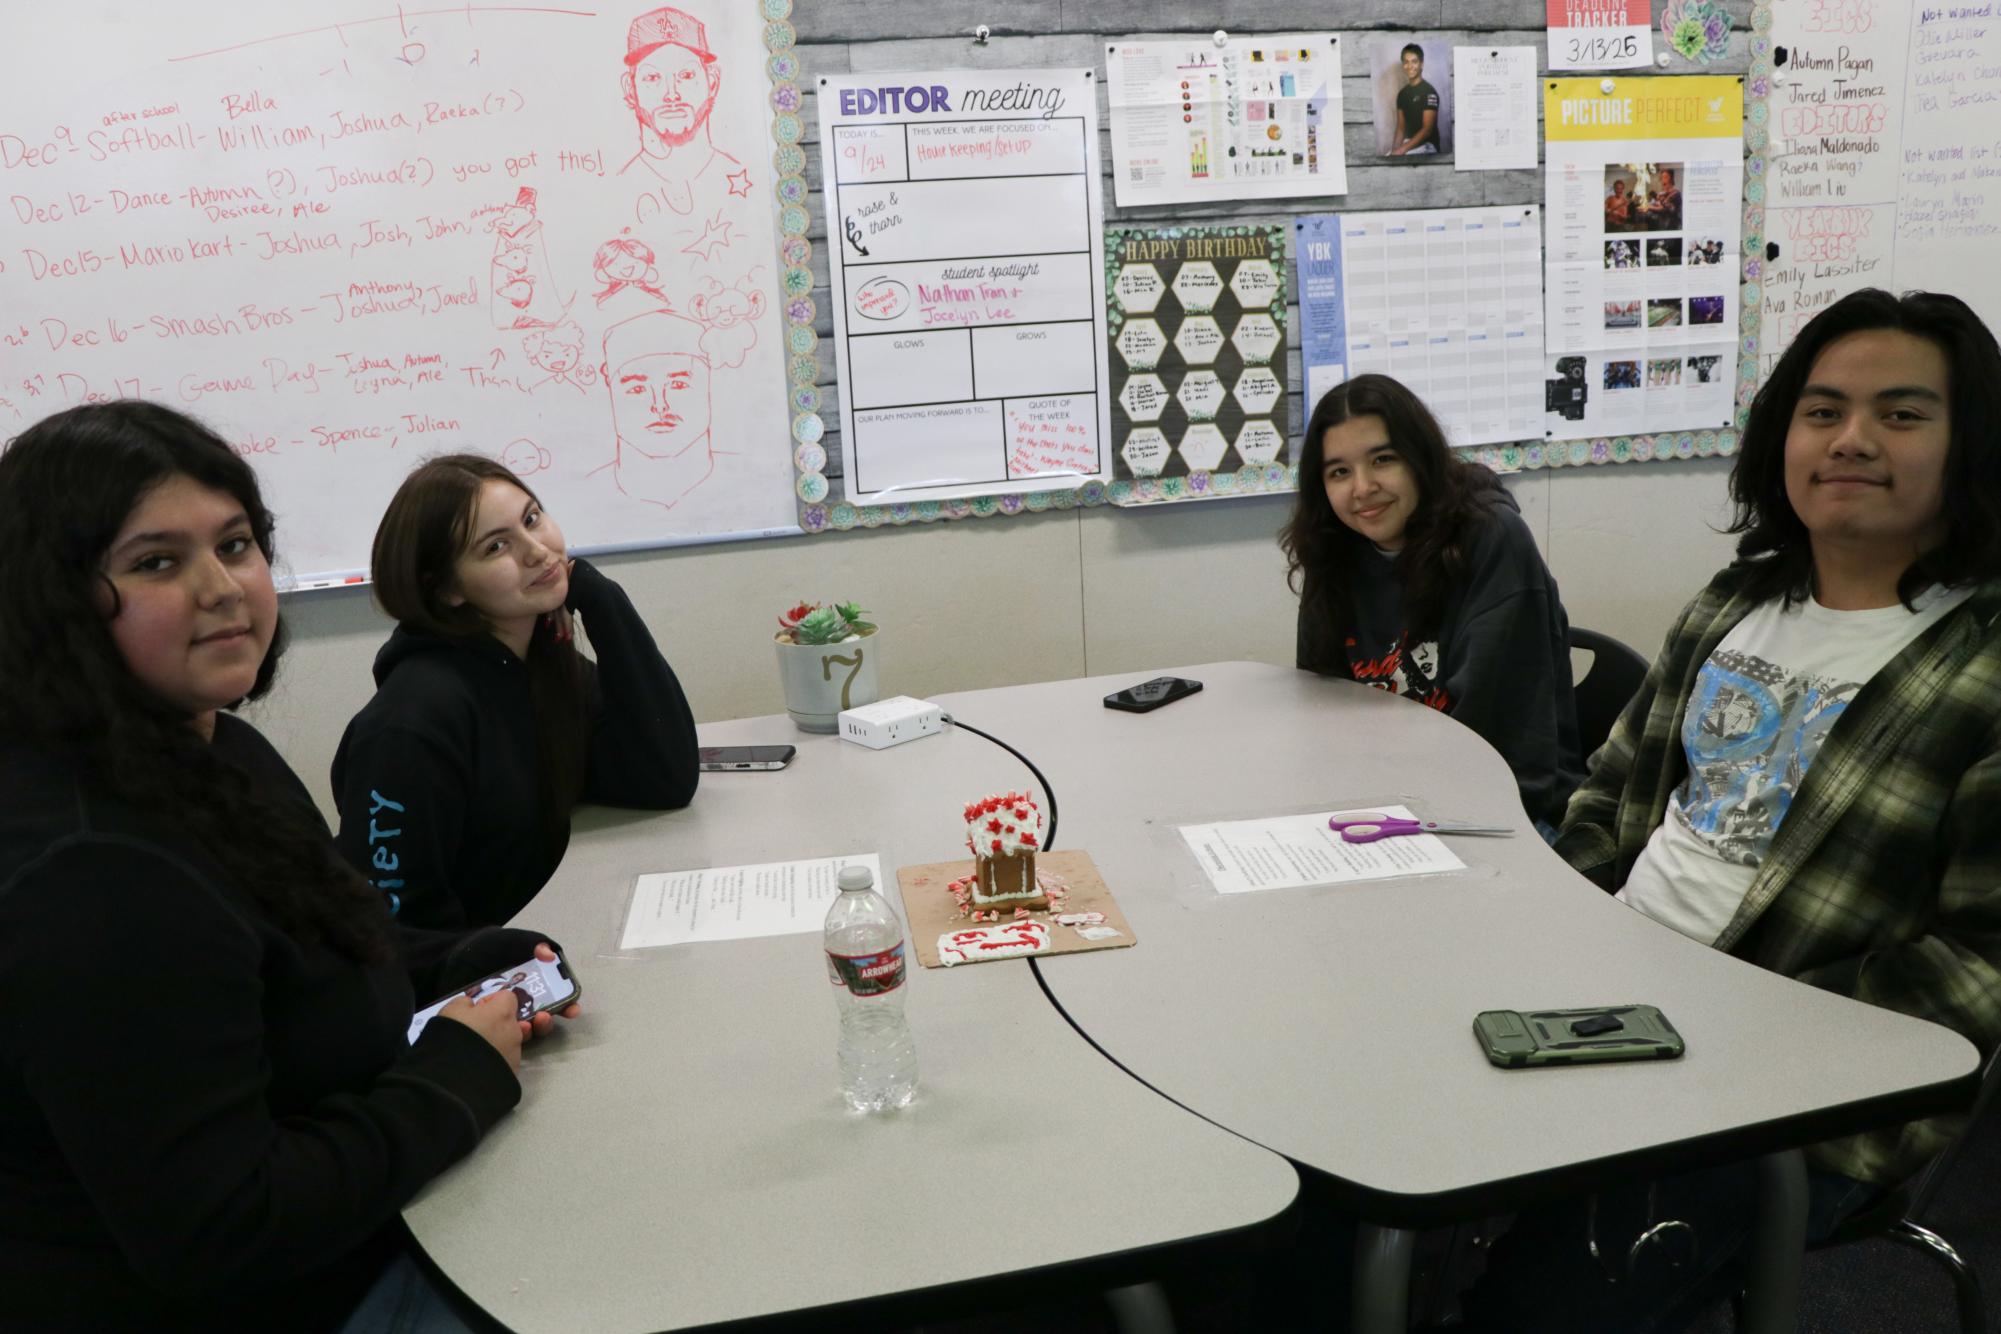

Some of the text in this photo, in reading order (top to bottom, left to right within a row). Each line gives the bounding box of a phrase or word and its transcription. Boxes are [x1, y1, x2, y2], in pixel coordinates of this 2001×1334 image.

[1566, 11, 1628, 28] TRACKER
[1790, 45, 1873, 80] Autumn Pagan
[839, 82, 1065, 120] EDITOR meeting
[1788, 79, 1886, 103] Jared Jimenez
[102, 102, 181, 127] after school
[221, 90, 279, 120] Bella
[1561, 98, 1632, 126] PICTURE
[1636, 96, 1704, 124] PERFECT
[839, 130, 867, 139] TODAY
[912, 127, 931, 136] THIS
[963, 126, 976, 135] WE
[979, 125, 994, 134] ARE
[997, 123, 1035, 133] FOCUSED
[0, 134, 58, 169] Dec
[1820, 136, 1880, 156] Maldonado
[10, 195, 63, 225] Dec
[109, 190, 172, 214] Dance
[452, 163, 492, 182] you
[504, 151, 538, 178] got
[558, 149, 605, 177] this!
[293, 201, 331, 218] Ale
[857, 200, 885, 219] rose
[869, 212, 902, 235] thorn
[120, 242, 184, 270] Mario
[1126, 237, 1266, 261] HAPPY BIRTHDAY
[1307, 242, 1331, 261] YBK
[942, 262, 1039, 281] student spotlight
[1764, 255, 1881, 290] Emily Lassiter
[918, 284, 975, 304] Nathan
[979, 284, 1006, 299] Tran
[1764, 288, 1837, 314] Ava Roman
[40, 318, 100, 351] Dec
[150, 313, 241, 338] Smash
[238, 304, 294, 331] Bros
[426, 276, 478, 313] Jared
[920, 305, 1015, 325] Jocelyn Lee
[893, 339, 925, 349] GLOWS
[1016, 331, 1047, 341] GROWS
[417, 370, 444, 384] Ale
[114, 378, 141, 400] 17
[1028, 399, 1071, 409] QUOTE OF
[400, 414, 461, 434] Julian
[857, 415, 874, 424] OUR
[875, 413, 895, 422] PLAN
[896, 411, 926, 420] MOVING
[928, 409, 963, 417] FORWARD
[1028, 412, 1070, 421] THE WEEK
[821, 648, 863, 710] 7
